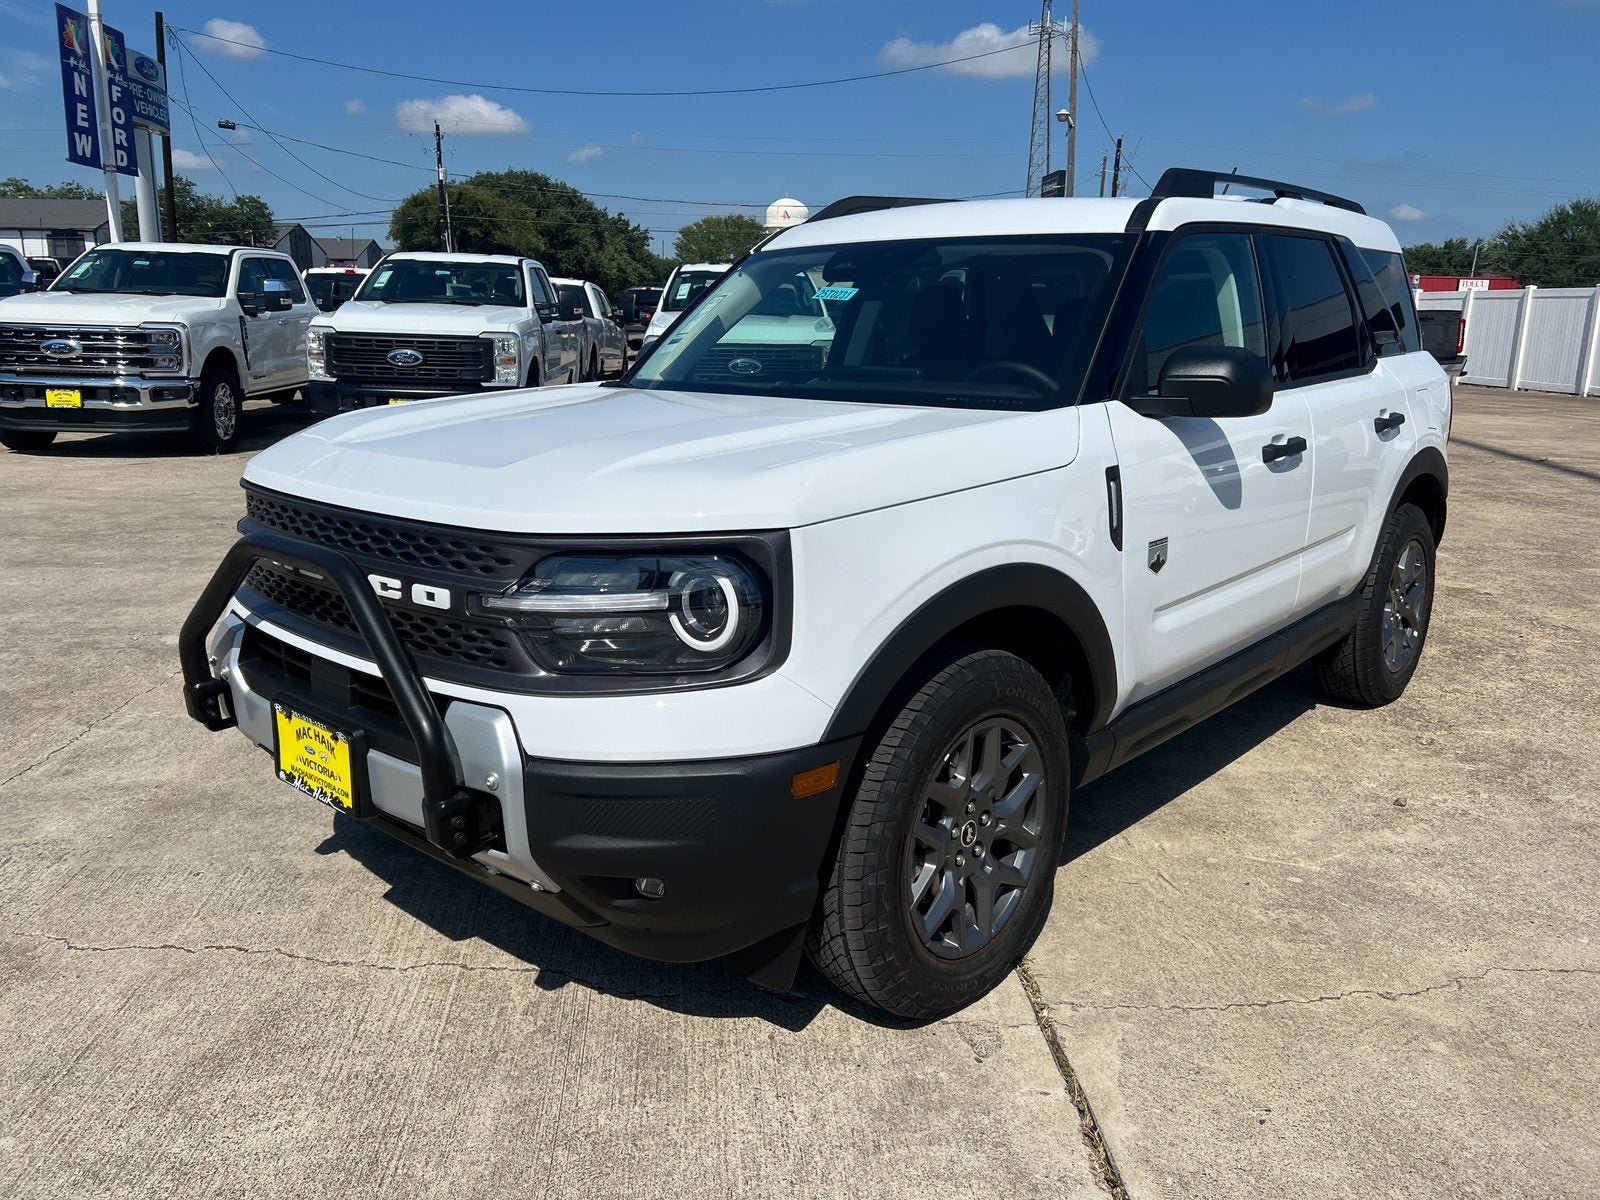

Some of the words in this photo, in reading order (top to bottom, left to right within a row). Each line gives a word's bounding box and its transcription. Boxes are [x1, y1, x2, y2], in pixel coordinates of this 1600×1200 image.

[73, 71, 93, 158] NEW
[111, 84, 128, 167] FORD
[133, 98, 168, 121] VEHICLES
[295, 726, 313, 742] MAC
[313, 729, 336, 759] HAIK
